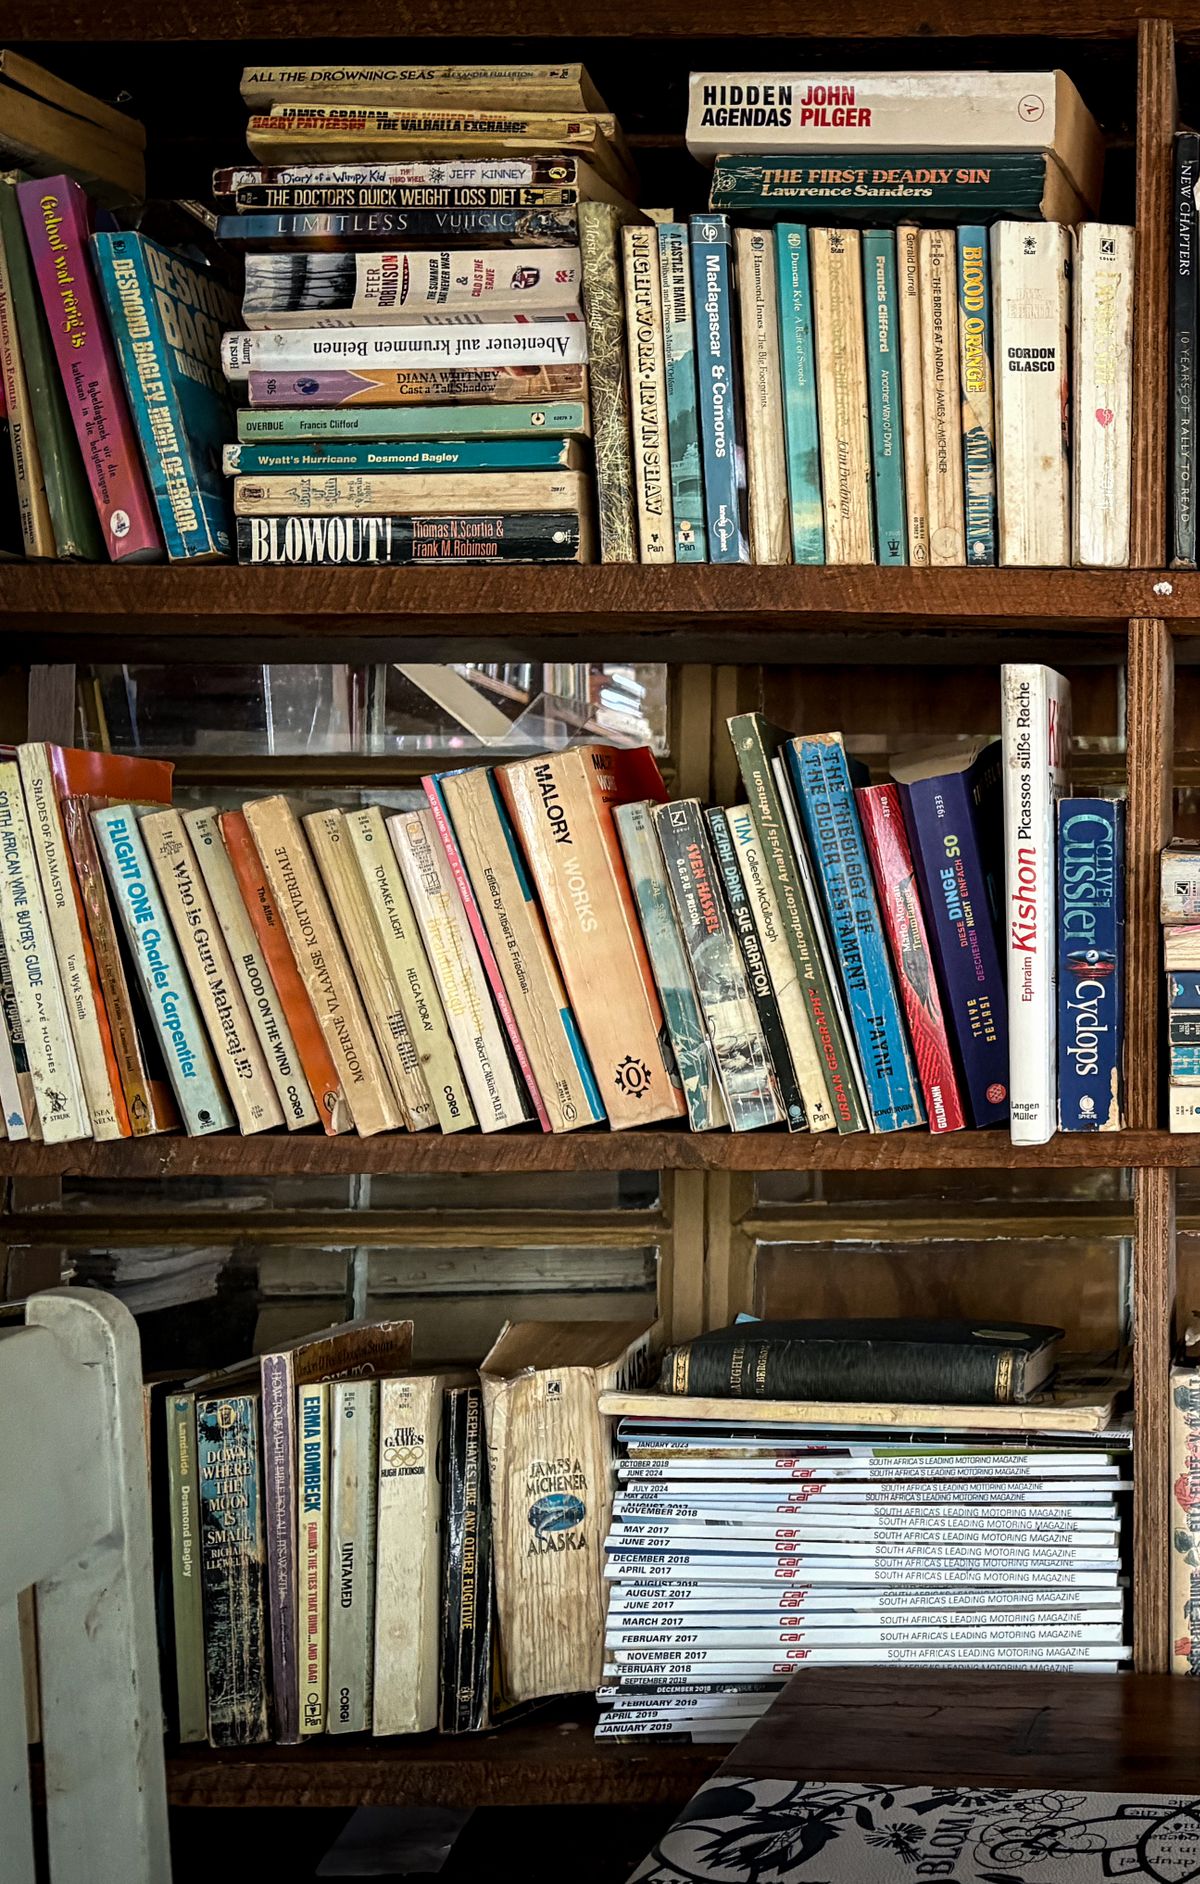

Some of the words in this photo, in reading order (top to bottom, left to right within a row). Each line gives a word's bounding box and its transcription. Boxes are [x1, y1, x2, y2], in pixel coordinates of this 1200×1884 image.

[248, 72, 275, 82] ALL
[279, 72, 305, 82] THE
[311, 71, 395, 81] DROWNING
[399, 71, 434, 80] SEAS
[703, 86, 792, 106] HIDDEN
[801, 86, 855, 106] JOHN
[701, 109, 792, 127] AGENDAS
[800, 108, 871, 127] PILGER
[449, 169, 476, 179] JEFF
[481, 168, 526, 179] KINNEY
[761, 170, 804, 184] THE
[808, 169, 867, 183] FIRST
[871, 169, 953, 184] DEADLY
[955, 169, 991, 183] SIN
[1180, 166, 1192, 197] NEW
[266, 190, 290, 205] THE
[294, 190, 355, 205] DOCTOR'S
[359, 190, 397, 205] QUICK
[400, 190, 451, 205] WEIGHT
[454, 190, 485, 204] LOSS
[489, 190, 516, 204] DIET
[760, 185, 852, 197] Lawrence
[855, 185, 932, 197] Sanders
[278, 215, 409, 233] LIMITLESS
[1179, 203, 1190, 276] CHAPTERS
[40, 196, 68, 251] Geloof
[54, 255, 74, 285] wat
[72, 333, 86, 348] is
[366, 269, 380, 299] PETER
[378, 256, 399, 307] ROBINSON
[963, 246, 984, 311] BLOOD
[706, 255, 721, 357] Madagascar
[313, 342, 367, 356] Beinen
[374, 340, 449, 357] krummen
[453, 339, 481, 355] auf
[486, 336, 570, 356] Abenteuer
[965, 318, 986, 392] ORANGE
[1008, 348, 1055, 359] GORDON
[711, 366, 725, 379] &
[1009, 361, 1055, 372] GLASCO
[246, 421, 284, 431] OVERDUE
[300, 420, 327, 430] Francis
[330, 419, 358, 429] Clifford
[639, 381, 659, 449] IRWIN
[711, 382, 726, 457] Comoros
[258, 456, 299, 466] Wyatt's
[302, 455, 357, 464] Hurricane
[368, 453, 418, 463] Desmond
[421, 452, 458, 464] Bagley
[643, 455, 662, 515] SHAW
[250, 519, 392, 562] BLOWOUT!
[1017, 682, 1031, 728] Rache
[1017, 732, 1031, 767] süße
[1017, 771, 1031, 839] Picassos
[734, 815, 752, 845] TIM
[534, 763, 572, 846] MALORY
[563, 856, 597, 933] WORKS
[1062, 813, 1113, 942] Cussler
[1011, 847, 1037, 955] Kishon
[107, 819, 140, 881] FLIGHT
[128, 884, 155, 924] ONE
[142, 928, 169, 989] Charles
[160, 992, 197, 1079] Carpentier
[1021, 957, 1033, 1002] Ephraim
[1066, 980, 1108, 1075] Cyclops
[287, 1086, 304, 1119] CORGI
[304, 1396, 321, 1438] ERMA
[304, 1441, 321, 1512] BOMBECK
[341, 1542, 354, 1609] UNTAMED
[780, 1617, 805, 1625] car
[888, 1650, 917, 1658] SOUTH
[919, 1649, 955, 1657] AFRICA'S
[958, 1649, 995, 1657] LEADING
[998, 1648, 1044, 1656] MOTORING
[1046, 1648, 1090, 1656] MAGAZINE
[601, 1724, 647, 1732] JANUARY
[650, 1723, 672, 1731] 2019
[916, 1817, 975, 1877] BLOM
